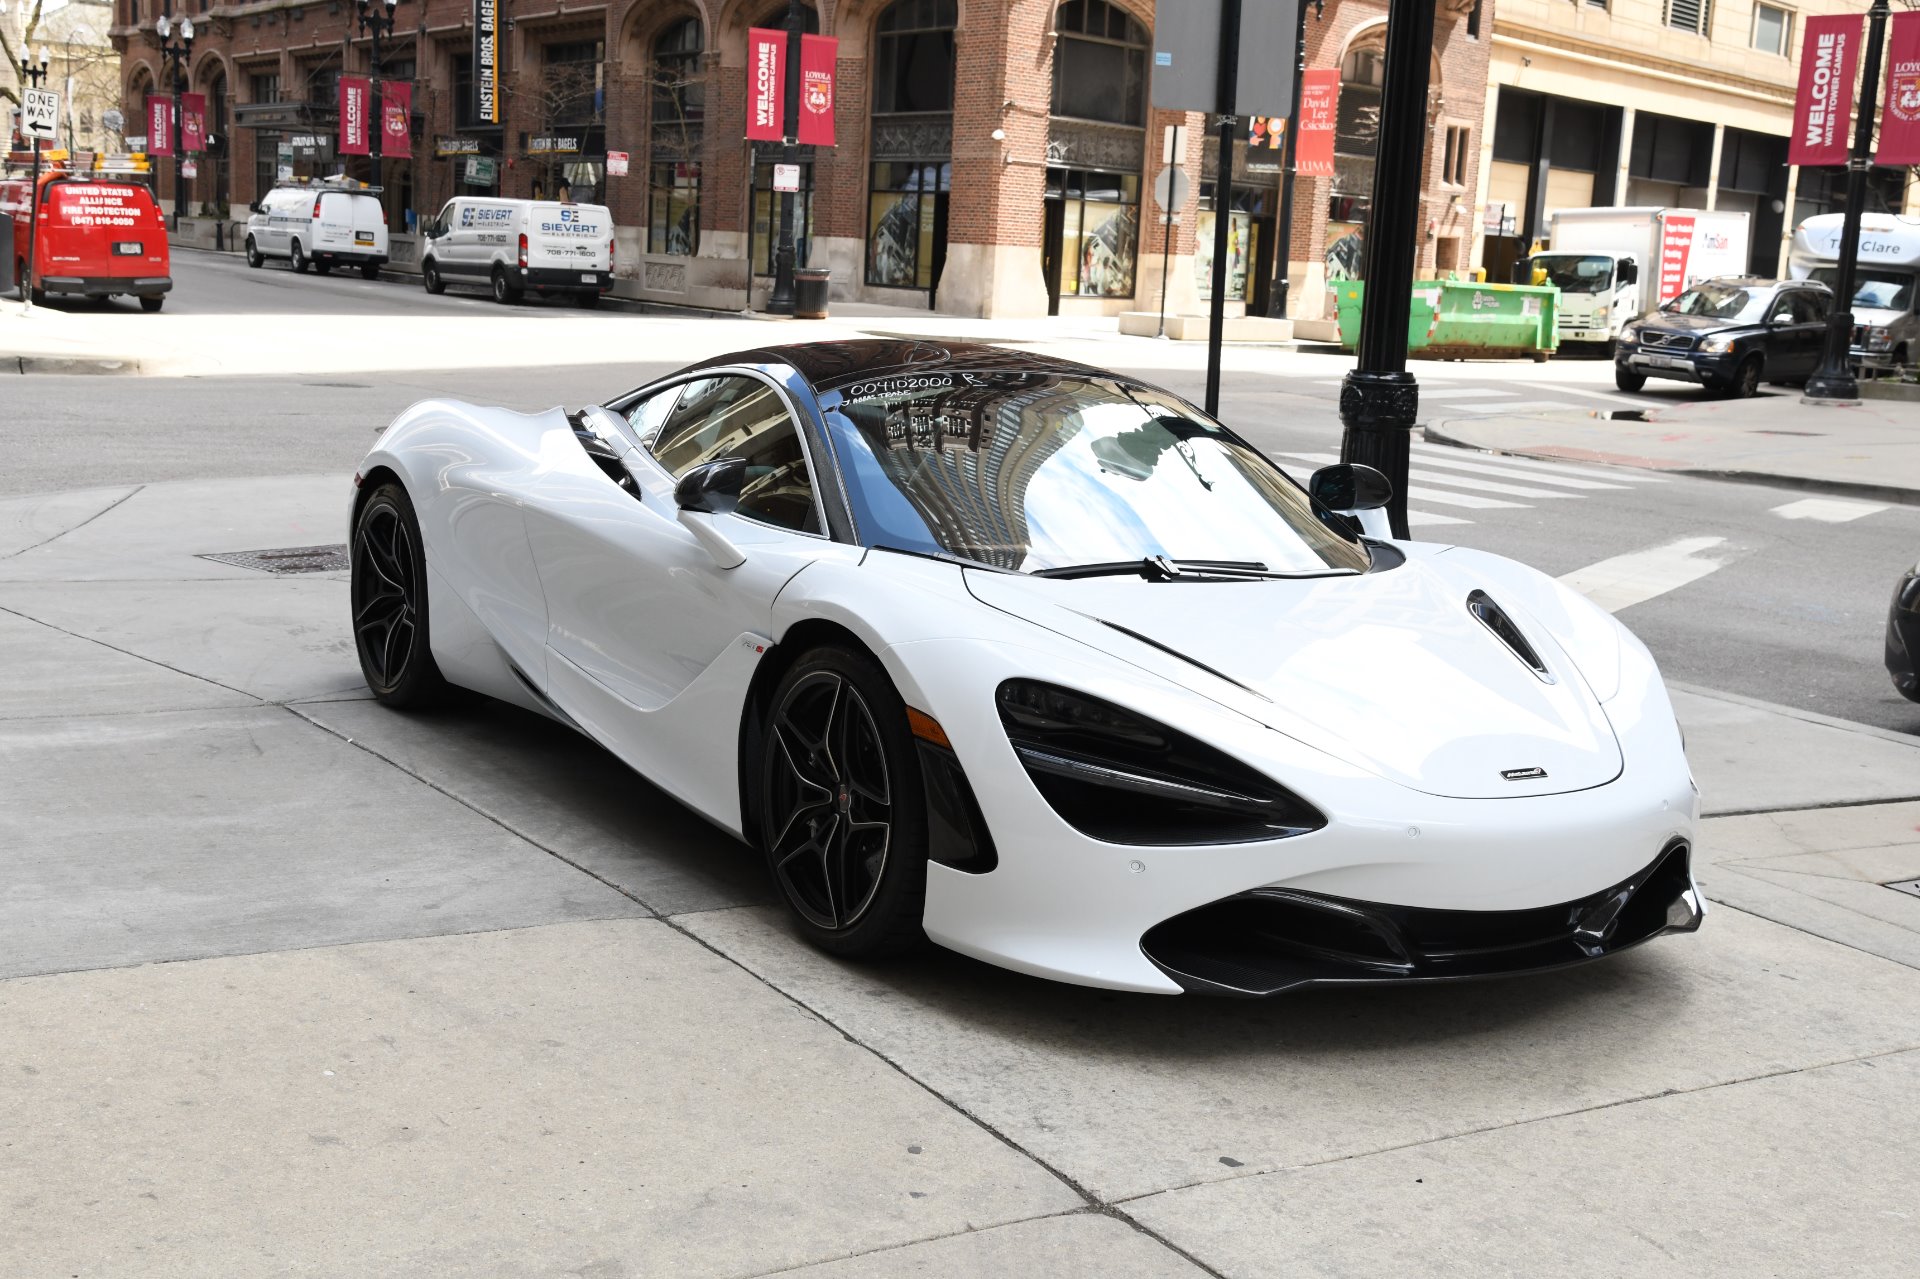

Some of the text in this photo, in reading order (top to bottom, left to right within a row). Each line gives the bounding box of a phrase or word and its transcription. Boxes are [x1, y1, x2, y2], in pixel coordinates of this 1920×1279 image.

[480, 0, 494, 120] EINSTEIN BROS. BAGE
[805, 70, 831, 80] LOYOLA
[757, 42, 770, 126] WELCOME
[1806, 34, 1835, 146] WELCOME
[1824, 33, 1846, 146] WATER TOWER CAMPUS
[28, 93, 54, 107] ONE
[1304, 97, 1329, 108] David
[27, 106, 54, 119] WAY
[347, 87, 356, 144] WELCOME
[1312, 108, 1328, 118] Lee
[558, 137, 577, 150] BAGELS
[1296, 160, 1333, 172] LUMA
[65, 187, 133, 197] UNITED STATES
[62, 206, 141, 216] FIRE PROTECTION
[478, 209, 513, 221] SIEVERT
[541, 222, 598, 233] SIEVERT
[1861, 241, 1900, 254] Clare
[851, 377, 952, 395] 004102000
